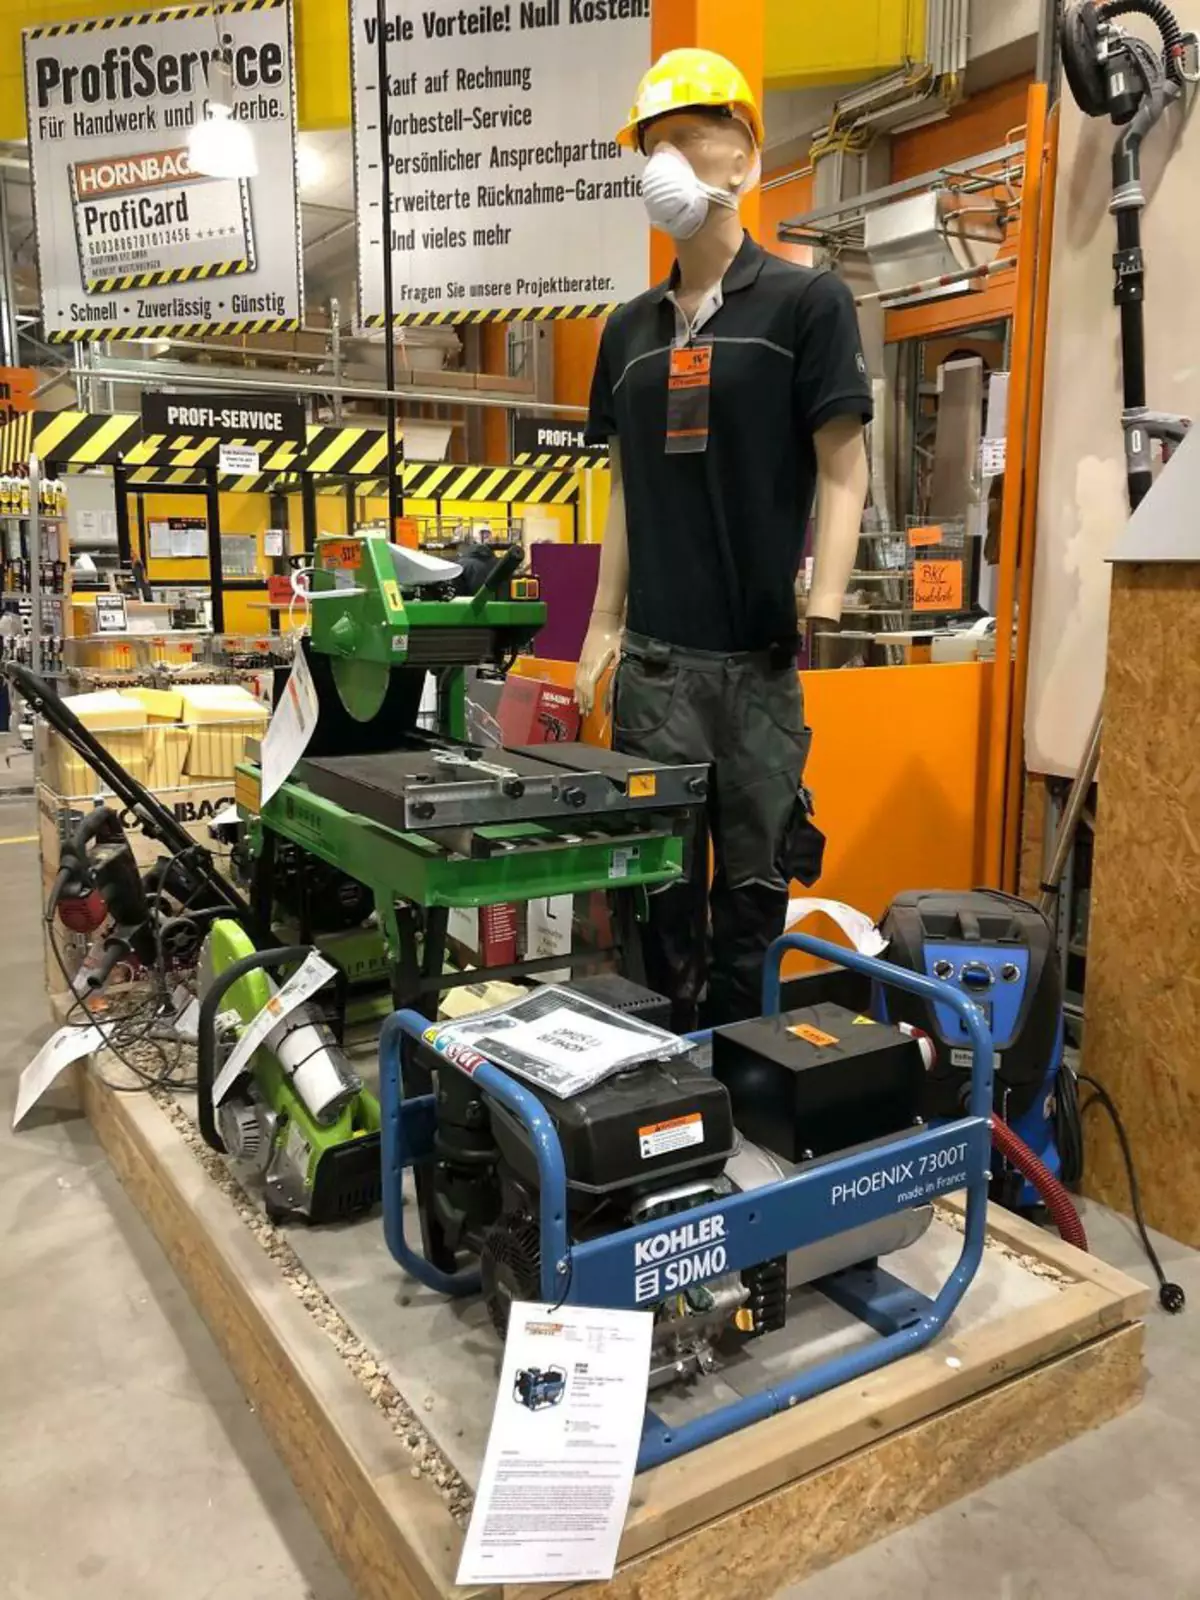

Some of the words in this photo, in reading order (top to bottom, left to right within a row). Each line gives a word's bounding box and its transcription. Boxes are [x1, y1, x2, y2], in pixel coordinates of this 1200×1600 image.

[364, 14, 413, 44] Vele
[422, 9, 510, 39] Vorteile!
[519, 0, 559, 29] Null
[569, 0, 650, 25] Kosten!
[424, 69, 449, 94] auf
[456, 65, 532, 91] Rechnung
[39, 115, 65, 140] Für
[73, 104, 156, 137] Handwerk
[164, 101, 195, 127] und
[79, 154, 193, 193] HORNBAC
[387, 149, 482, 175] Persönlicher
[84, 192, 188, 236] ProfiCard
[389, 187, 470, 213] Erweiterte
[391, 228, 415, 251] Und
[422, 225, 466, 250] vieles
[473, 223, 511, 247] mehr
[400, 283, 442, 304] Fragen
[446, 281, 465, 298] Sie
[469, 281, 511, 297] unsere
[516, 275, 615, 298] Projektberater.
[70, 301, 117, 322] Schnell
[137, 297, 212, 320] Zuverlässig
[232, 292, 286, 315] Günstig
[167, 406, 284, 432] PROFI-SERVICE
[831, 1160, 914, 1206] PHOENIX
[918, 1142, 968, 1176] 7300T
[897, 1184, 924, 1203] made
[925, 1182, 935, 1193] in
[936, 1170, 967, 1190] France
[635, 1214, 726, 1266] KOHLER
[664, 1245, 727, 1291] SDMO
